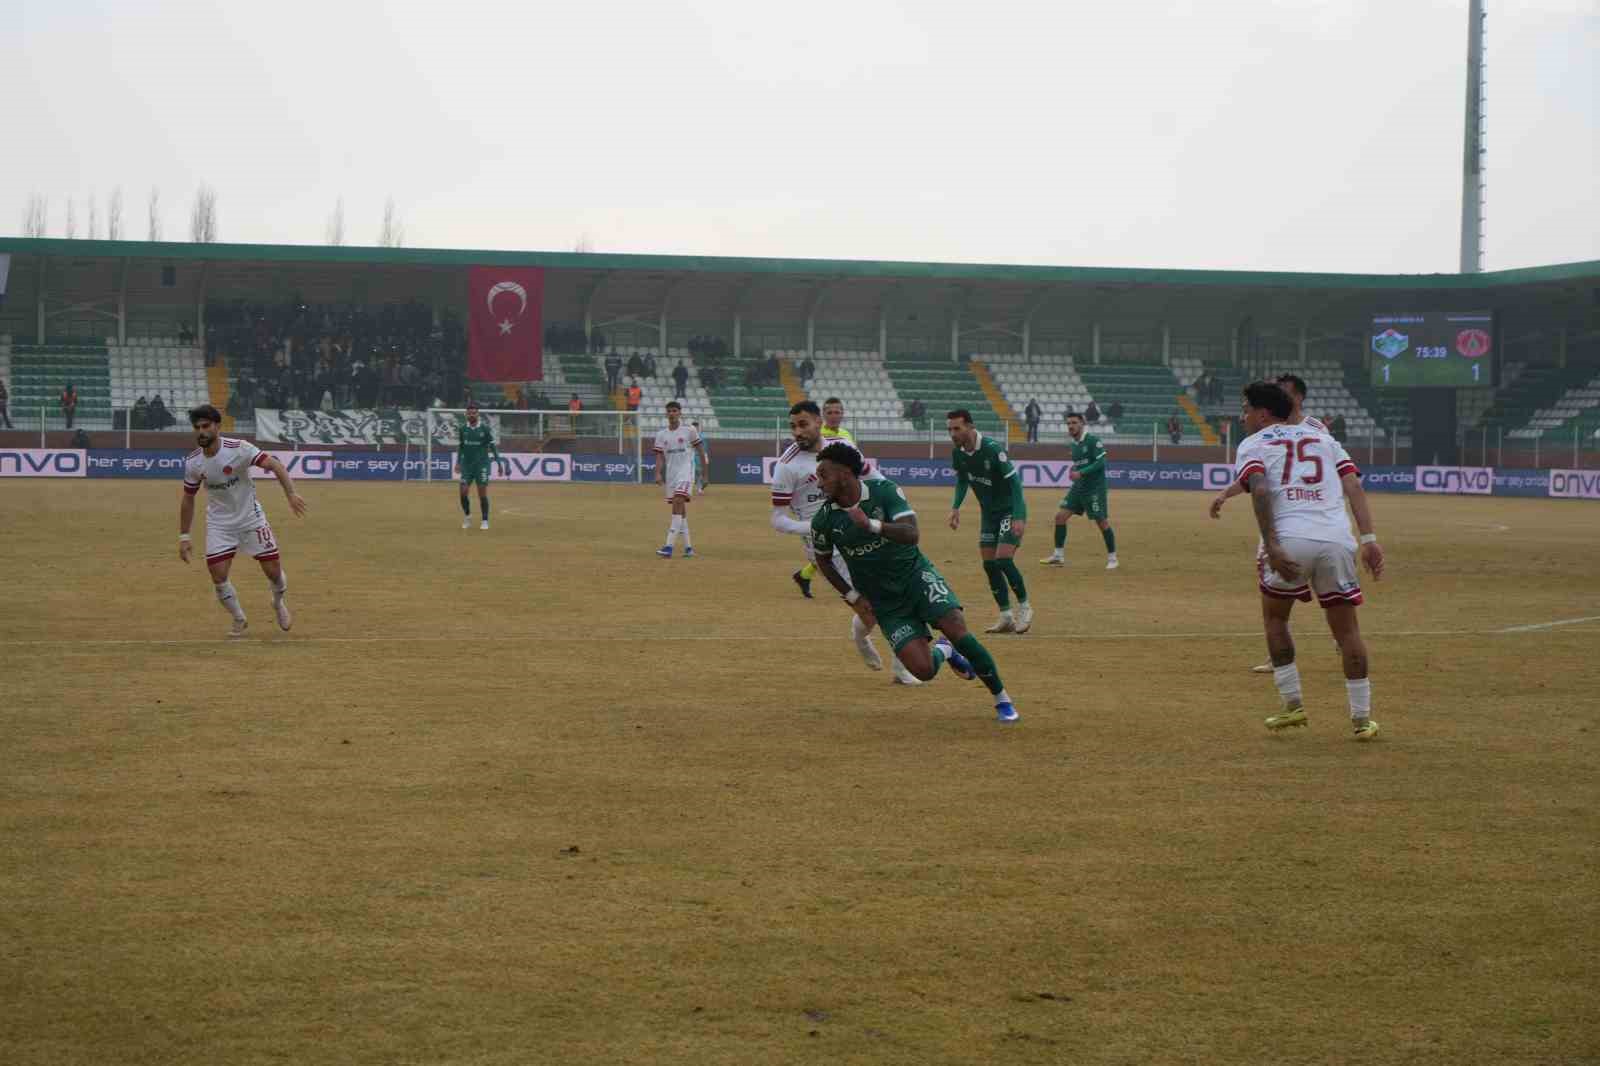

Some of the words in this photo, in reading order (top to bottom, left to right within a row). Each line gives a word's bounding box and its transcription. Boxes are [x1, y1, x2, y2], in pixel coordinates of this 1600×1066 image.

[1383, 364, 1390, 384] 1
[1472, 362, 1480, 382] 1
[88, 456, 118, 468] her
[122, 457, 154, 470] şey
[158, 456, 187, 469] on'
[367, 459, 399, 472] şey
[403, 458, 450, 469] onda
[489, 457, 566, 477] nvo
[572, 457, 597, 469] her
[606, 460, 635, 474] şey
[1264, 436, 1323, 484] 75
[878, 465, 904, 477] her
[909, 466, 938, 481] şey
[1128, 469, 1154, 484] şey
[1159, 467, 1202, 481] on'da
[1422, 471, 1490, 490] onvo
[928, 579, 950, 604] 20
